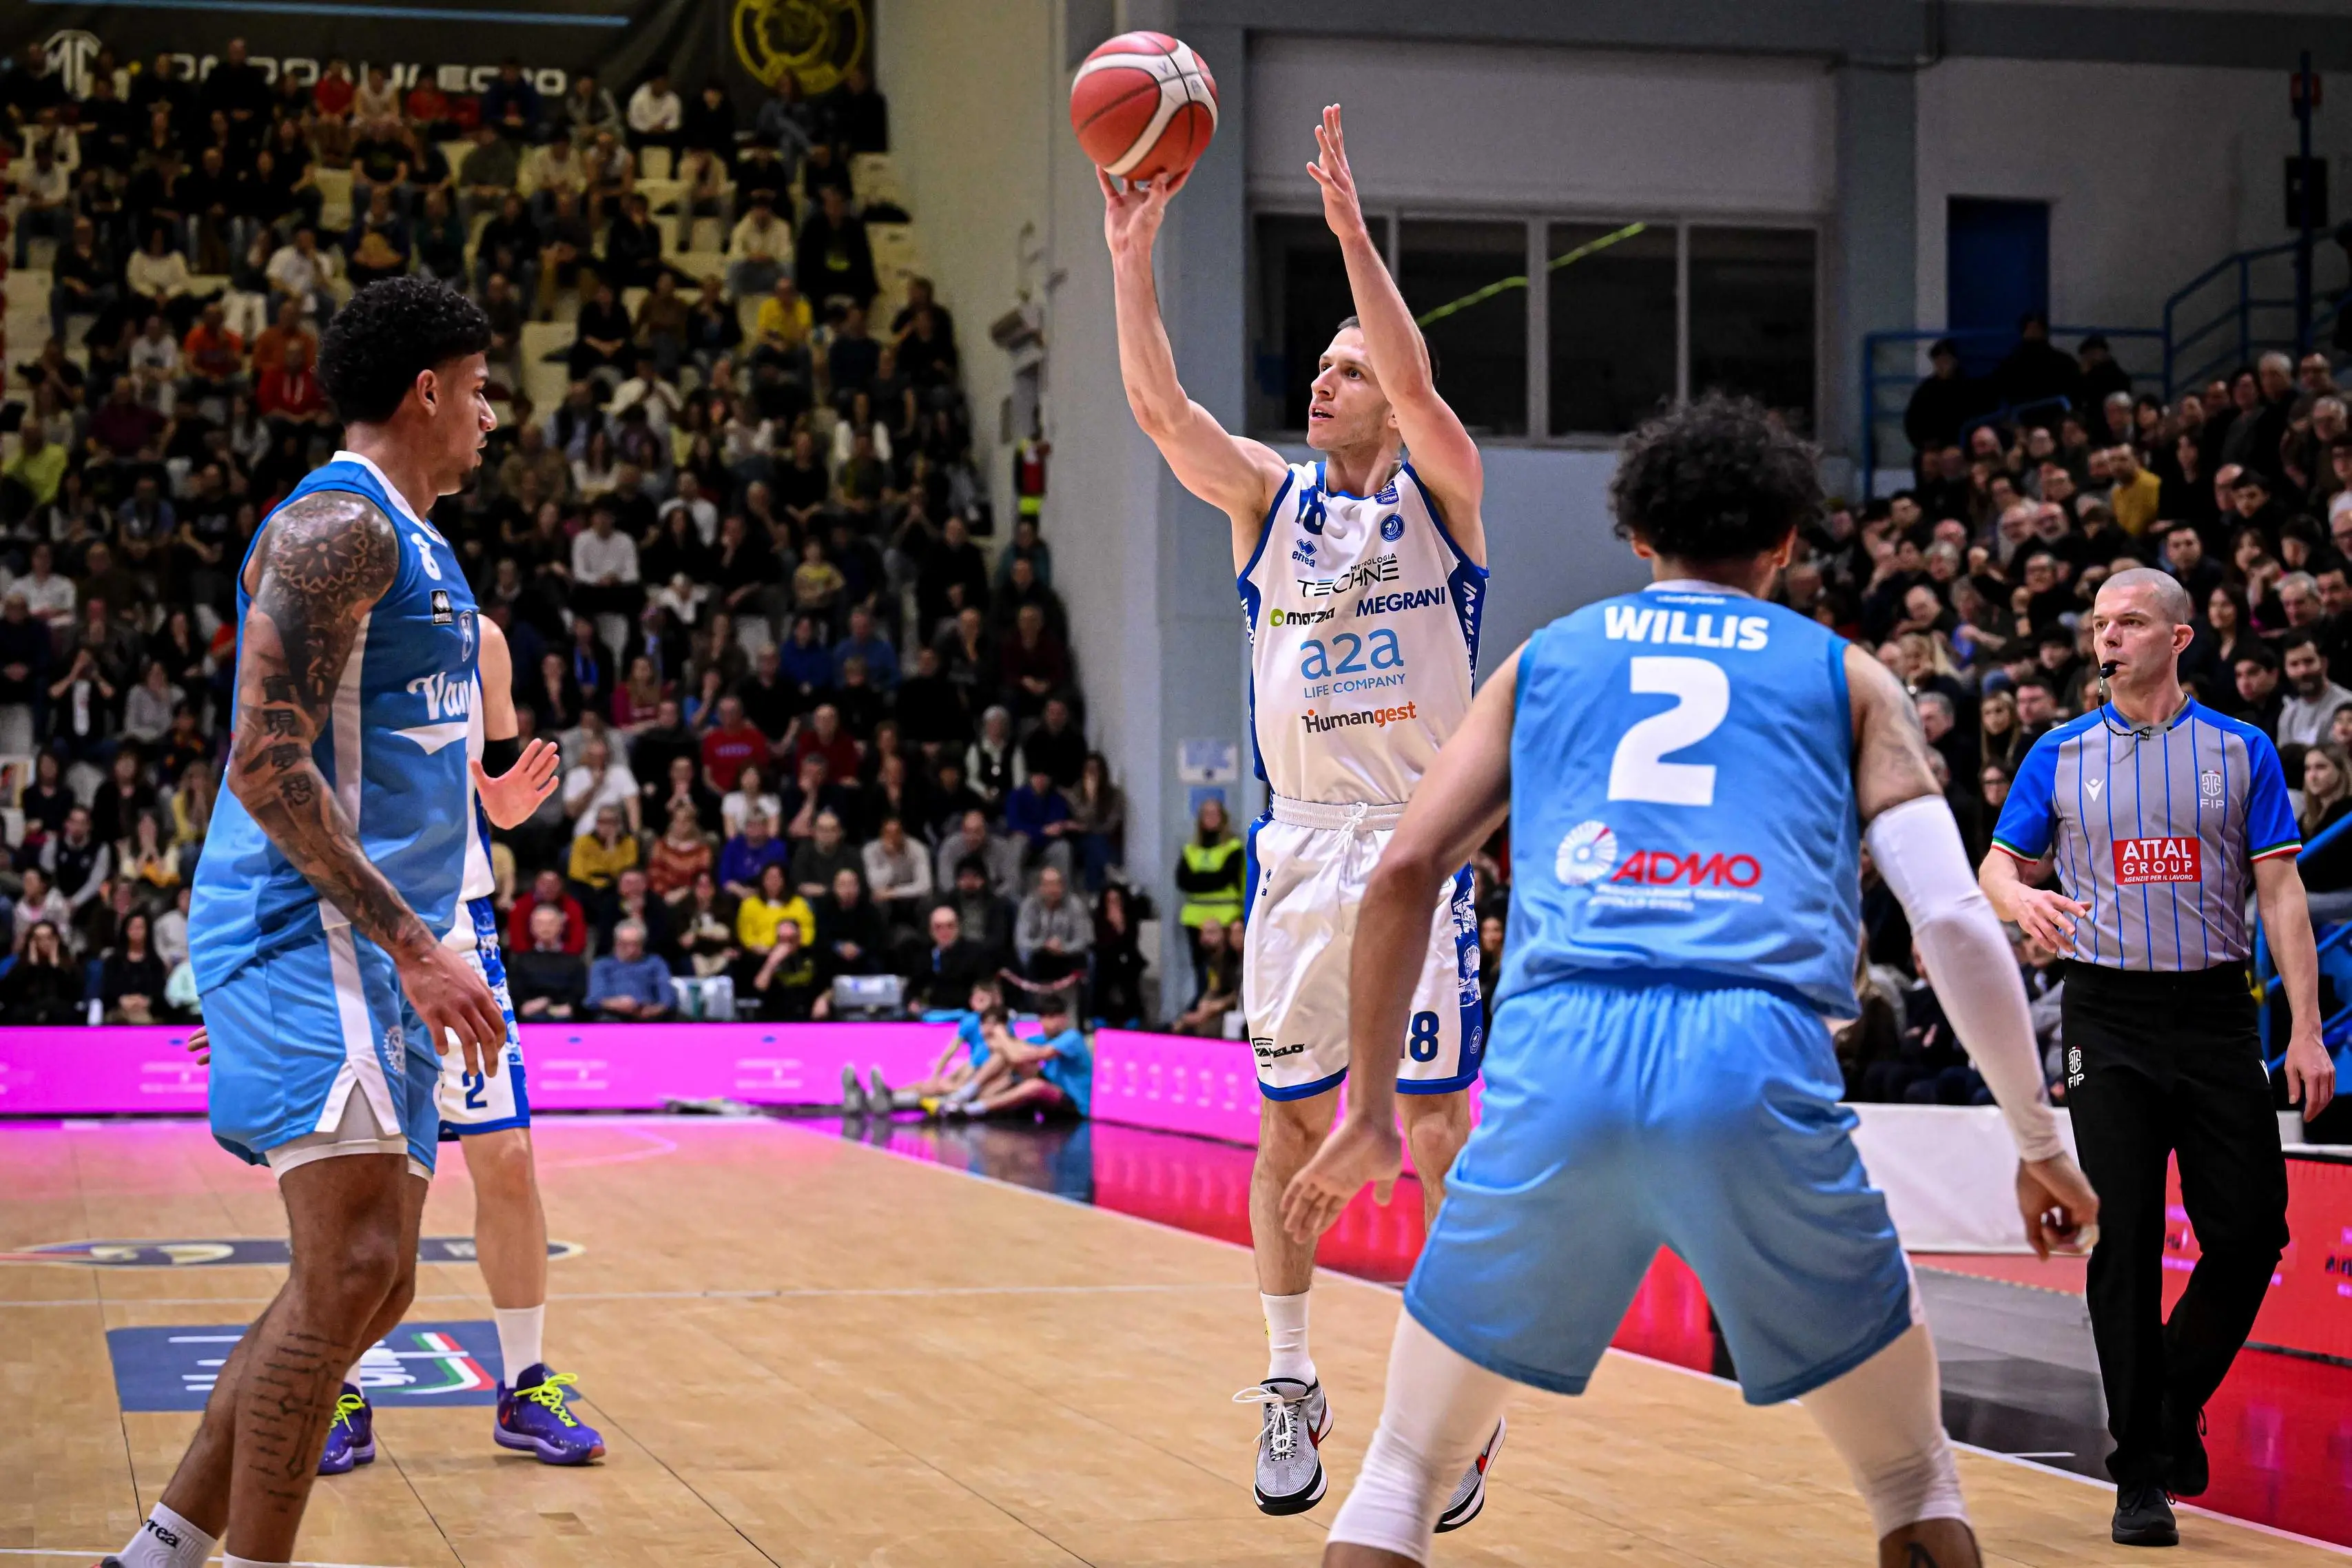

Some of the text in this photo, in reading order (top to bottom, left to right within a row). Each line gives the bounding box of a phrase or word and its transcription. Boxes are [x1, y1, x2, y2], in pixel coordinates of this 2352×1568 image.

[1292, 550, 1316, 568] errea
[1350, 553, 1396, 571] METROLOGIA
[1356, 586, 1445, 617] MEGRANI
[1605, 605, 1769, 652] WILLIS
[1300, 628, 1404, 680] a2a
[1304, 673, 1405, 699] LIFE COMPANY
[1301, 701, 1416, 733] Humangest
[1607, 656, 1731, 807] 2
[2200, 798, 2225, 809] FIP
[2123, 839, 2191, 861] ATTAL
[1610, 849, 1763, 888] ADMO
[2123, 860, 2192, 875] GROUP
[462, 1070, 488, 1110] 2
[2068, 1073, 2085, 1089] FIP
